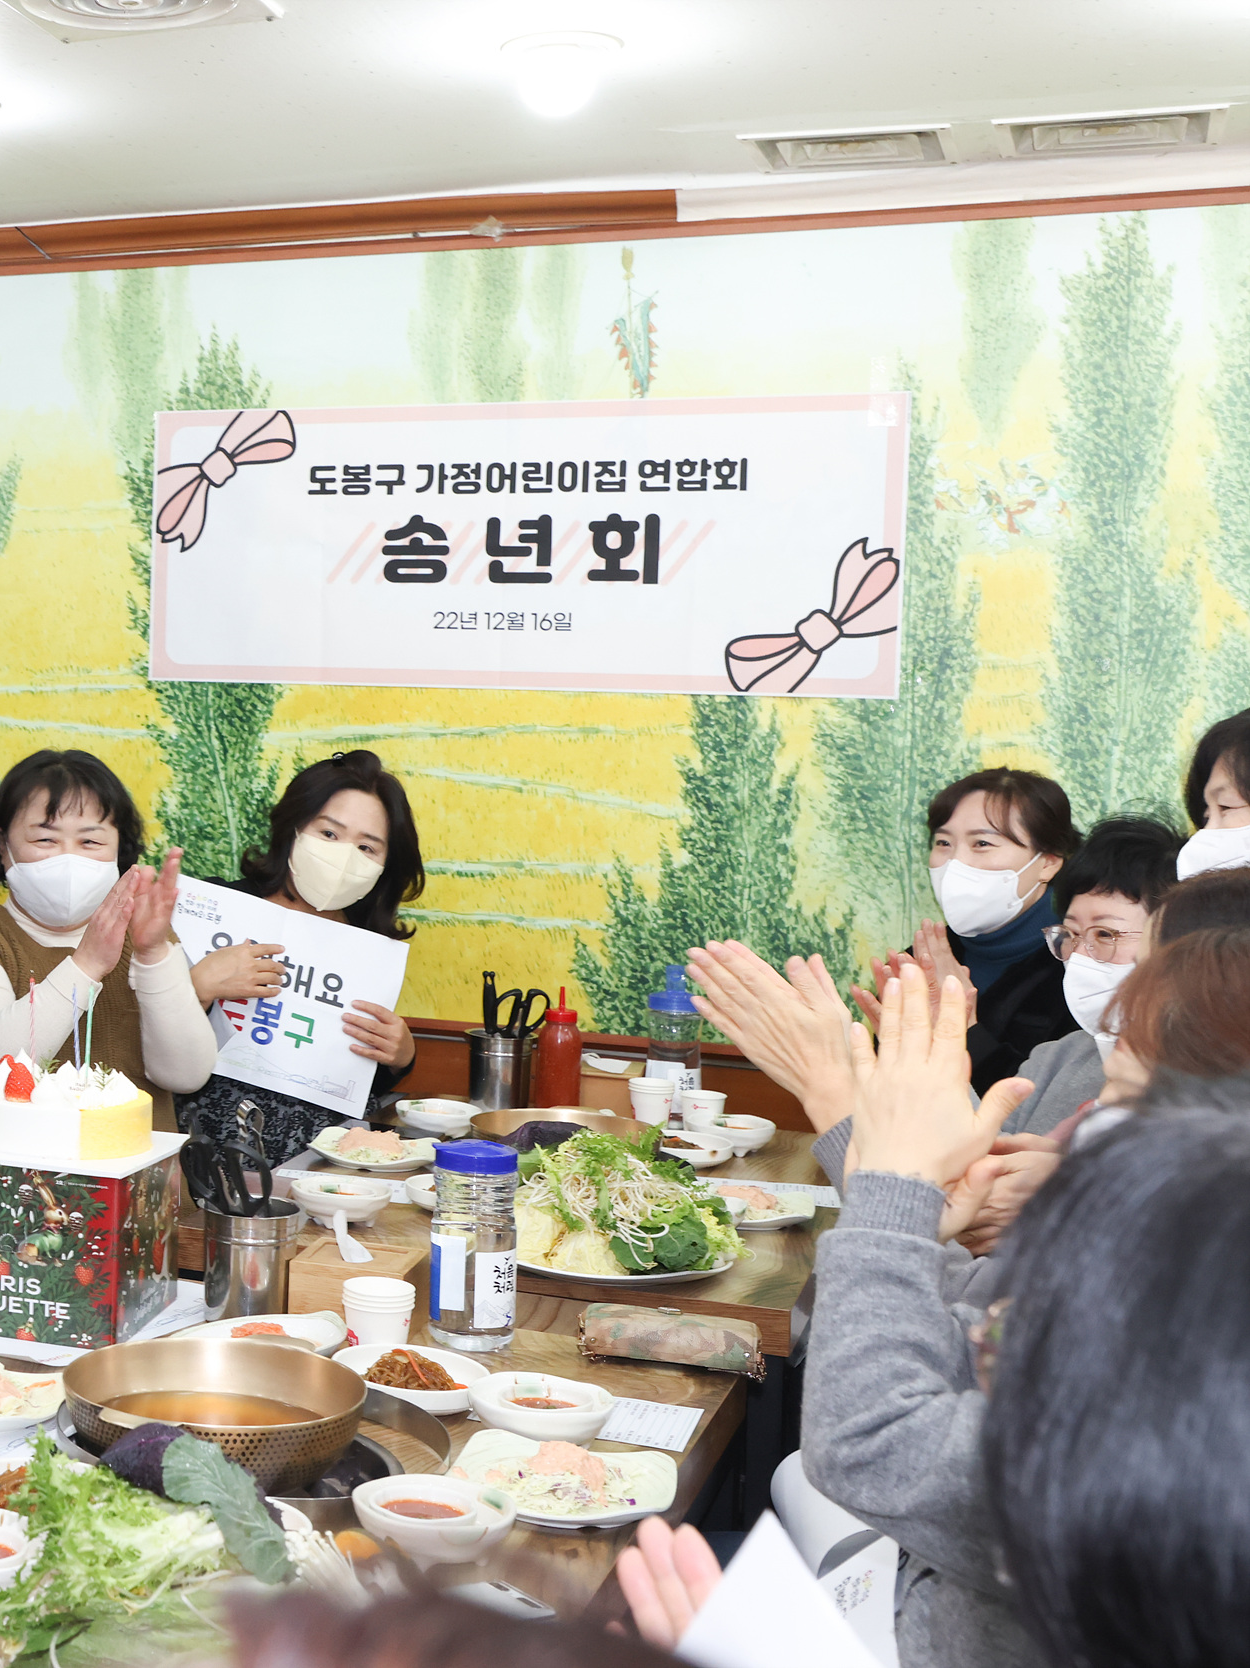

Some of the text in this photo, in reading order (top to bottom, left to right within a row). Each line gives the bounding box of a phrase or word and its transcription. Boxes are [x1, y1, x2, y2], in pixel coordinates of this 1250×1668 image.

[307, 457, 748, 496] 도봉구 가정어린이집 연합회
[433, 611, 572, 632] 22년 12월 16일
[493, 1264, 515, 1280] 처음
[493, 1281, 515, 1295] 처럼
